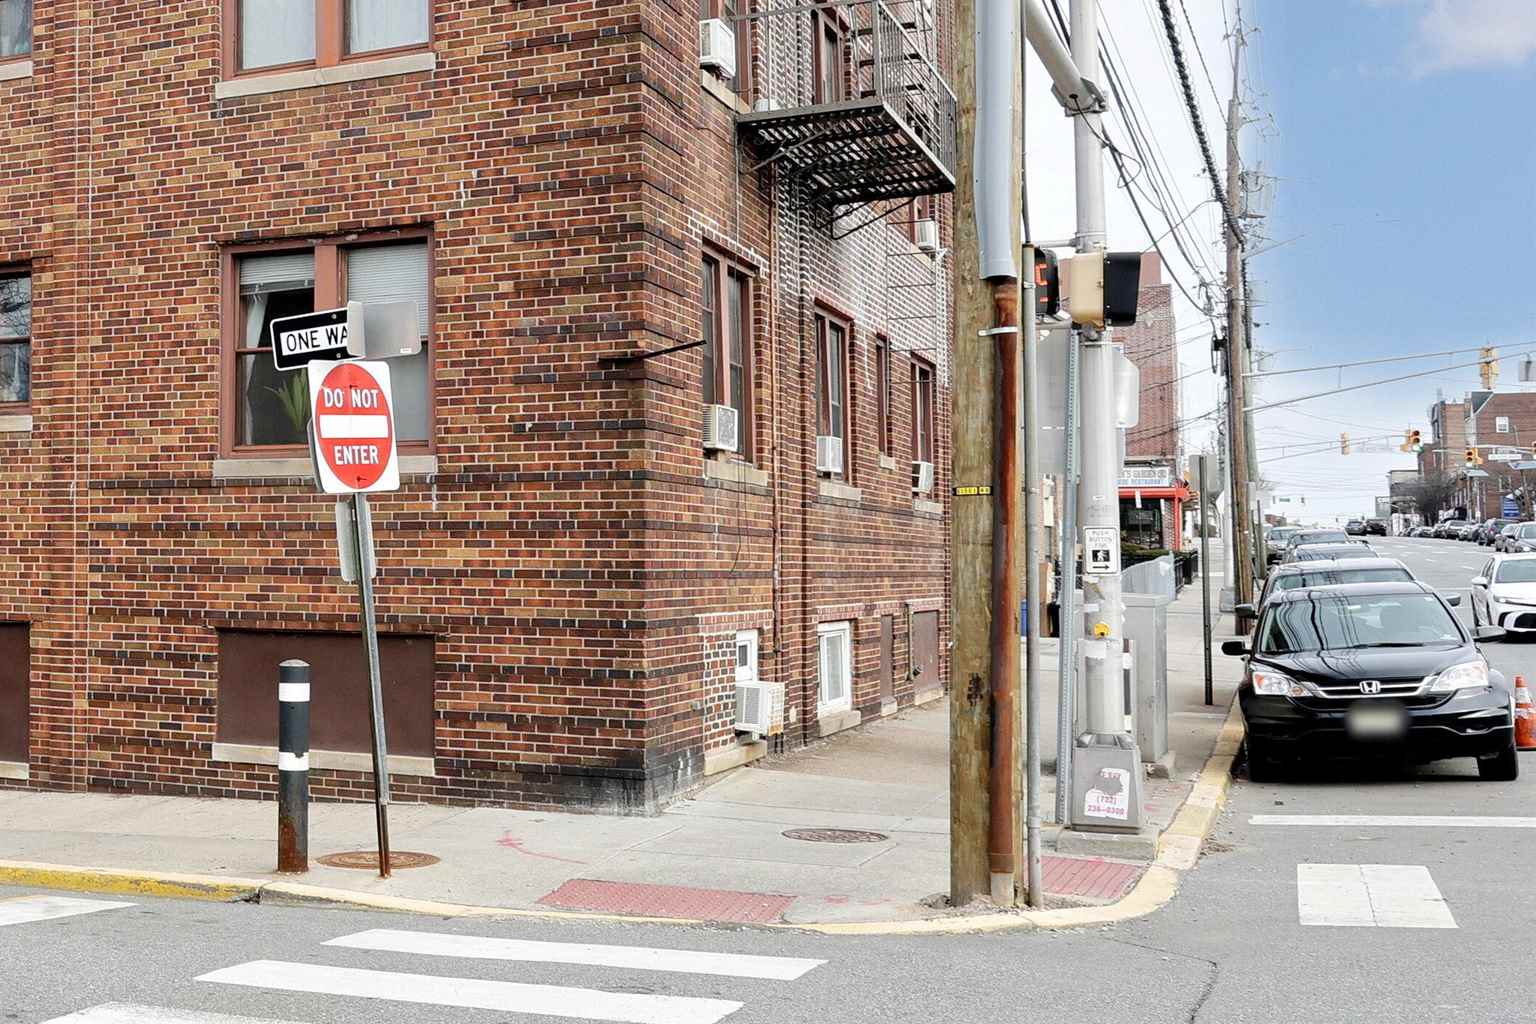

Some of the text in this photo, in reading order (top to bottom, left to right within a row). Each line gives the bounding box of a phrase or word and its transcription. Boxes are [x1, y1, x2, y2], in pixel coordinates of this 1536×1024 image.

[286, 325, 348, 352] ONE WA
[324, 388, 379, 408] DO NOT
[334, 445, 379, 465] ENTER
